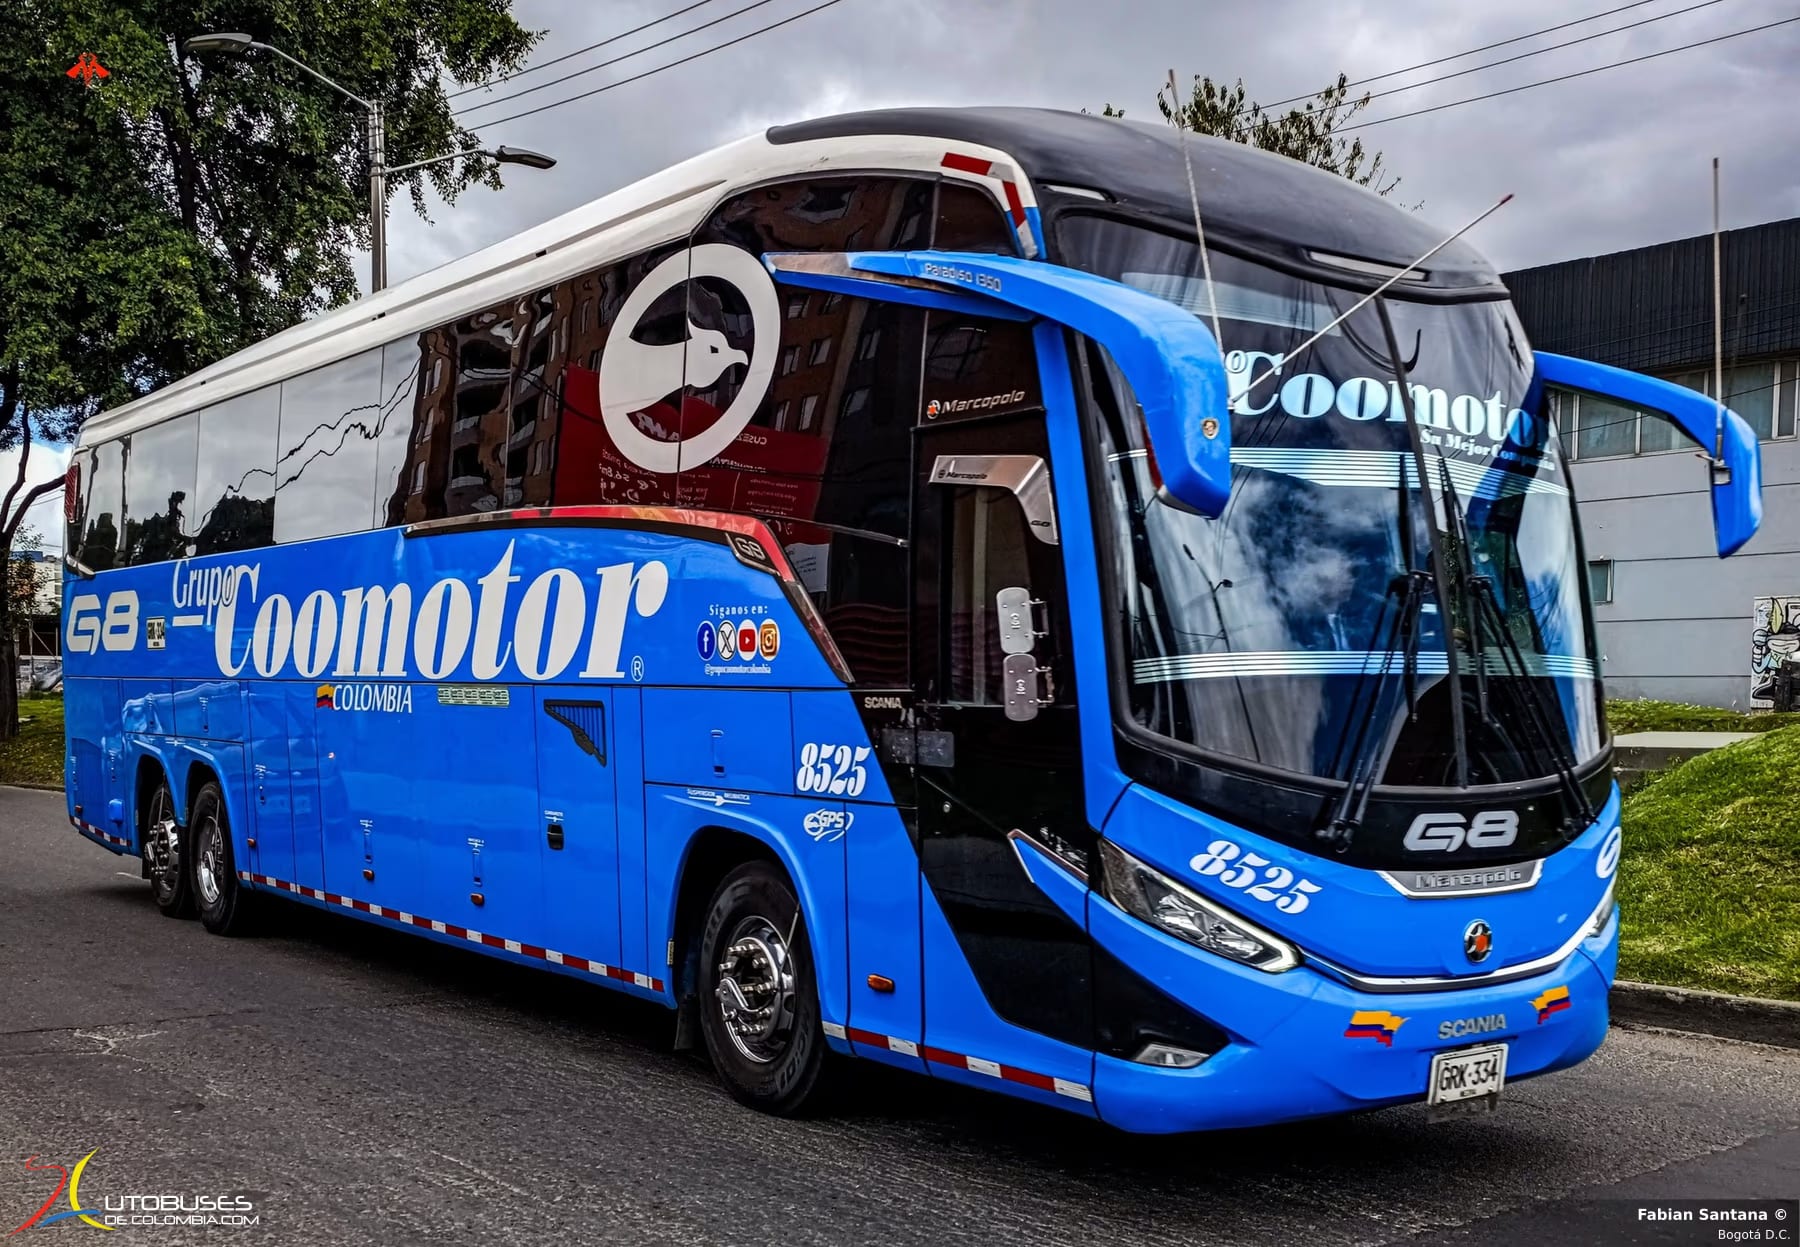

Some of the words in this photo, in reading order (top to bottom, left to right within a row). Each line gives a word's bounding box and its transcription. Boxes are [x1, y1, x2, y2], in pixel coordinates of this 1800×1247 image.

[923, 262, 973, 283] Paradiso
[975, 272, 1002, 292] 1350
[941, 389, 1026, 415] Marcopolo
[1420, 428, 1441, 446] Su
[1445, 433, 1491, 457] Mejor
[945, 470, 989, 481] Marcopolo
[735, 537, 767, 560] G8
[66, 589, 140, 656] G8
[172, 558, 236, 626] Grupo
[214, 537, 669, 681] Coomotor
[332, 683, 413, 714] COLOMBIA
[864, 696, 902, 709] SCANIA
[796, 742, 872, 797] 8525
[819, 811, 845, 829] GPS
[1402, 810, 1520, 852] G8
[1189, 839, 1324, 915] 8525
[1415, 867, 1522, 890] Marcopolo
[1438, 1013, 1507, 1040] SCANIA
